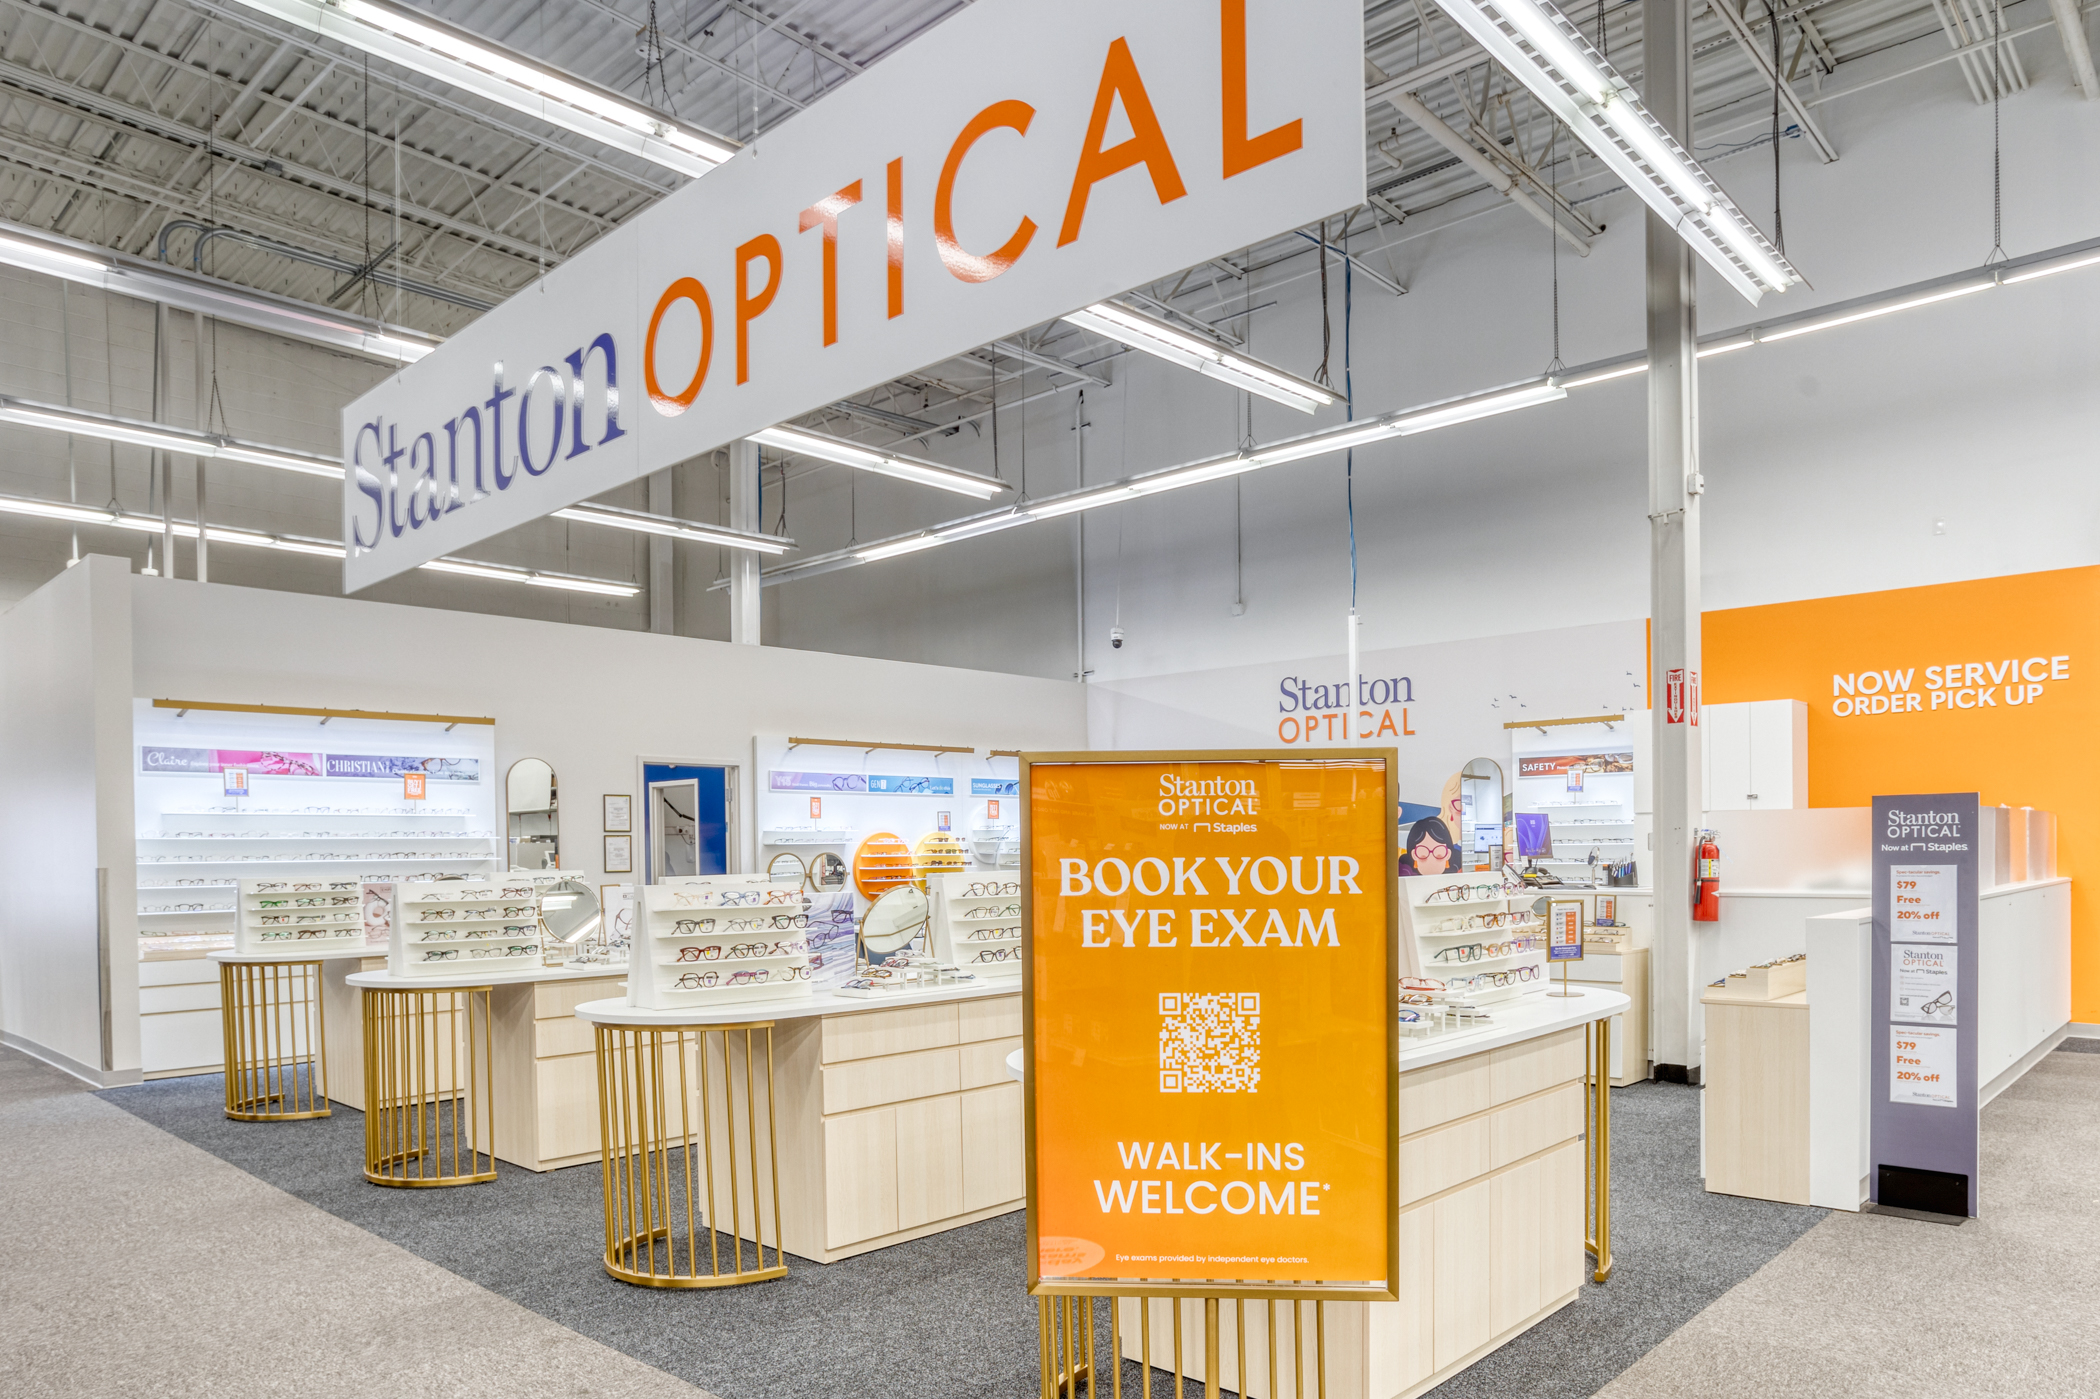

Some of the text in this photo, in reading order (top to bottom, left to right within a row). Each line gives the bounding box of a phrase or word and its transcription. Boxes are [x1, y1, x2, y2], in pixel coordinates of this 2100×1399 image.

[353, 0, 1304, 557] Stanton OPTICAL
[1669, 674, 1681, 682] FIRE
[1833, 655, 2070, 696] NOW SERVICE
[1279, 674, 1416, 713] Stanton
[1832, 684, 2044, 717] ORDER PICK UP
[1278, 708, 1416, 744] OPTICAL
[147, 751, 188, 767] Claire
[1522, 762, 1556, 772] SAFETY
[1159, 773, 1257, 797] Stanton
[1158, 798, 1258, 816] OPTICAL
[1888, 809, 1960, 826] Stanton
[1213, 822, 1258, 835] Staples
[1887, 825, 1961, 838] OPTICAL
[1927, 842, 1968, 853] Staples
[1059, 856, 1363, 897] BOOK YOUR
[1897, 880, 1917, 889] $79
[1897, 895, 1921, 903] Free
[1897, 911, 1940, 919] 20% off
[1081, 908, 1341, 948] EYE EXAM
[1903, 949, 1943, 960] Stanton
[1903, 958, 1944, 967] OPTICAL
[1896, 1040, 1917, 1050] $79
[1896, 1055, 1921, 1065] Free
[1897, 1071, 1940, 1082] 20% off
[1117, 1141, 1305, 1171] WALK-INS
[1115, 1253, 1129, 1263] Eye
[1159, 1254, 1194, 1264] provided
[1196, 1254, 1206, 1264] by
[1208, 1254, 1259, 1264] independent
[1277, 1255, 1309, 1264] doctors.
